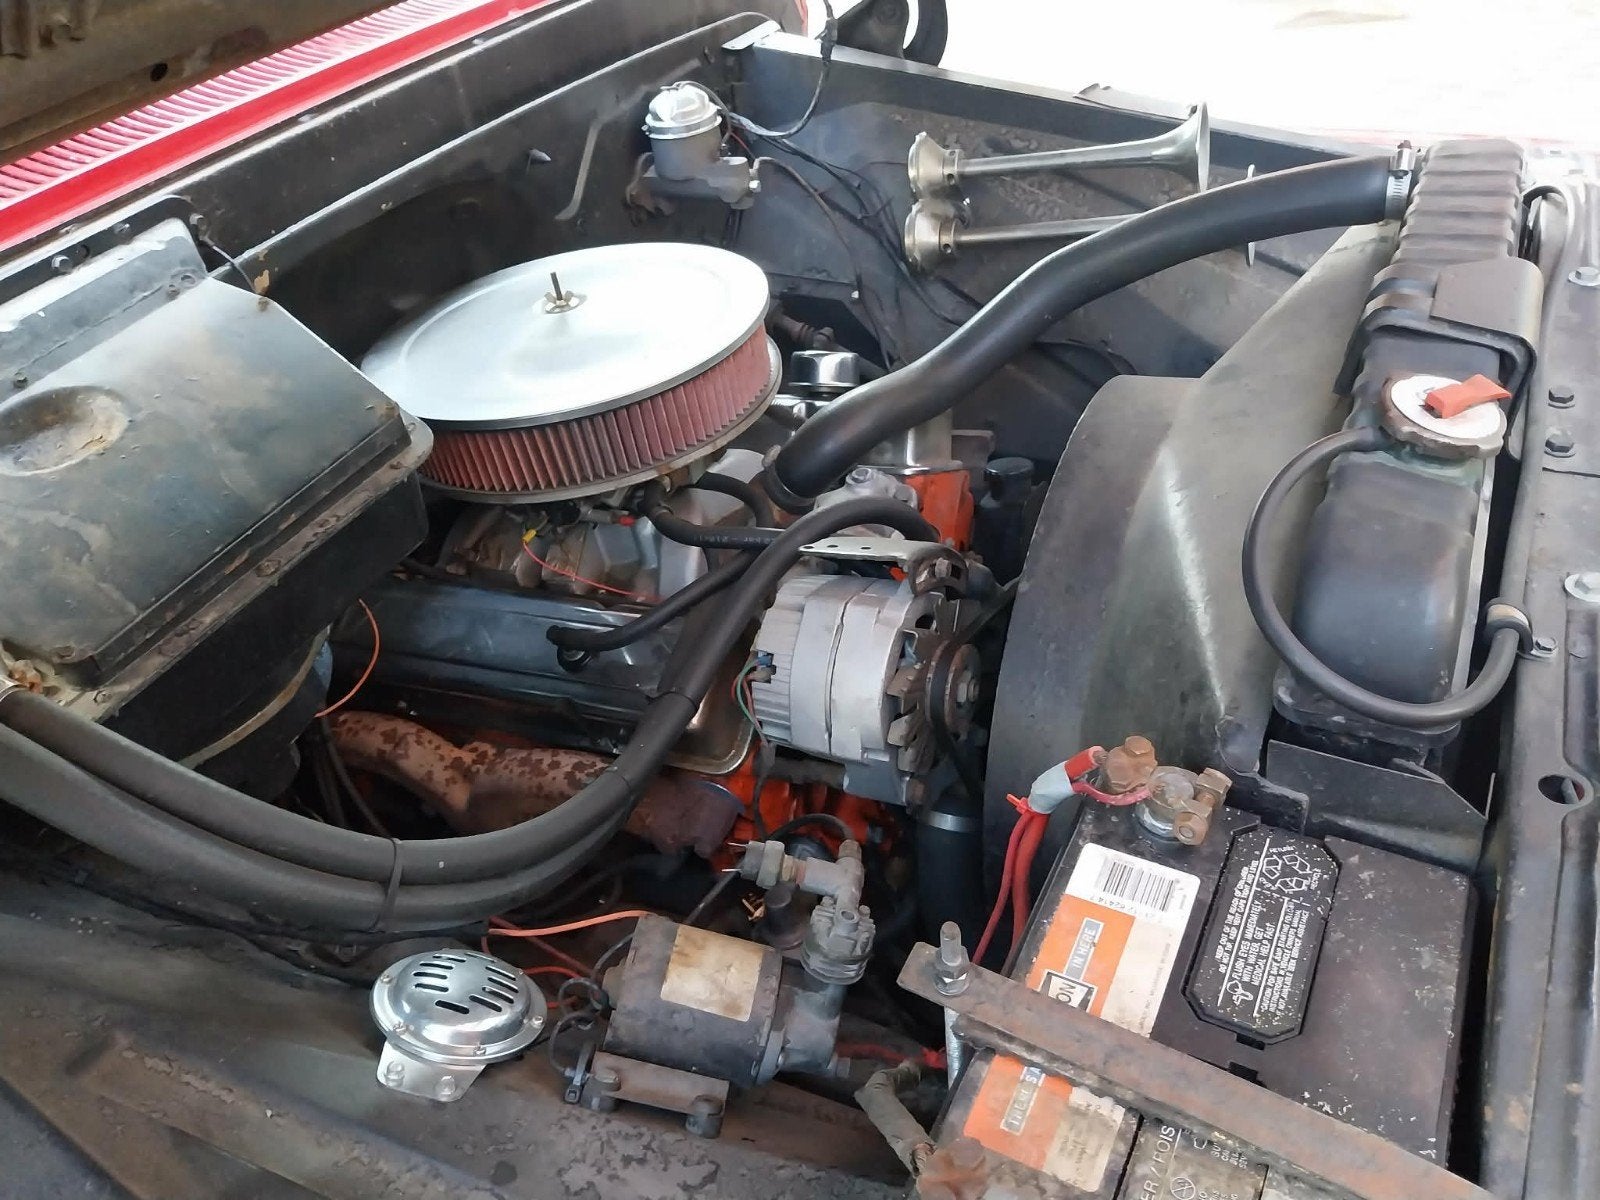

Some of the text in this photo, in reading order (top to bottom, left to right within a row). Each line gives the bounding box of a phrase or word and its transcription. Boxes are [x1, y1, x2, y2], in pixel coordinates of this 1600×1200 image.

[1070, 928, 1096, 969] IN HERE
[1232, 900, 1262, 980] FLUSH EYES IMMEDIATELY
[1241, 965, 1253, 982] WITH
[1254, 927, 1264, 939] GET
[1251, 959, 1266, 985] MEDICAL
[1259, 940, 1270, 956] HELP
